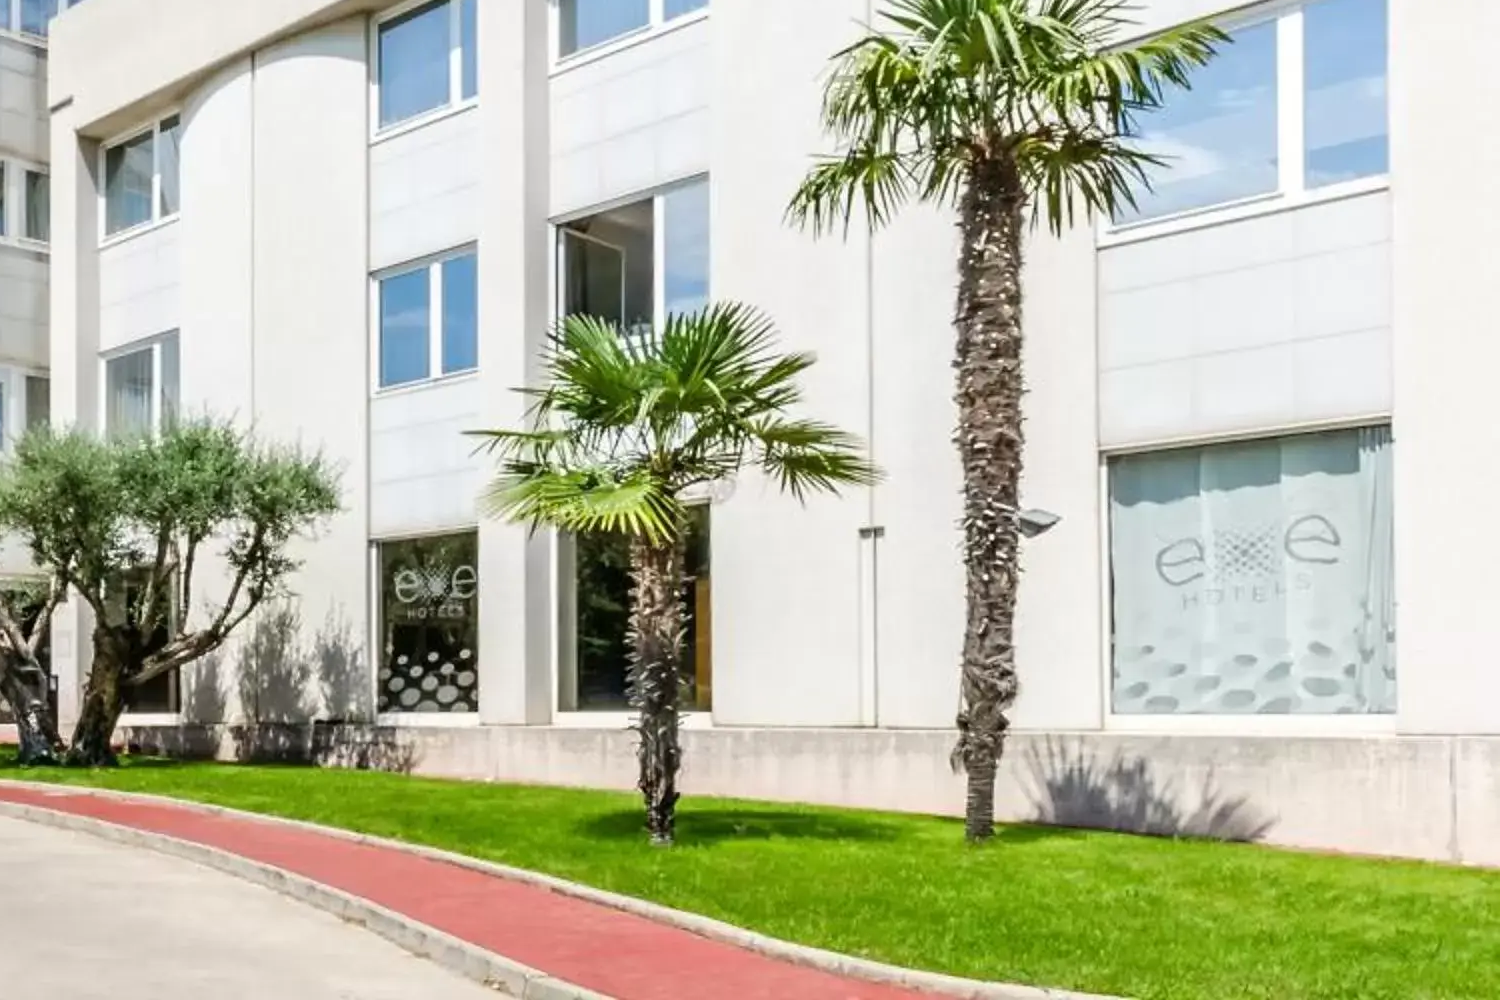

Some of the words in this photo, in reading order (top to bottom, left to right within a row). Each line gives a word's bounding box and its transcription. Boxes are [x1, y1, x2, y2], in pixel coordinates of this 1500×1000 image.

[1156, 514, 1340, 586] exe
[393, 564, 477, 603] exe
[1181, 571, 1312, 611] HOTELS
